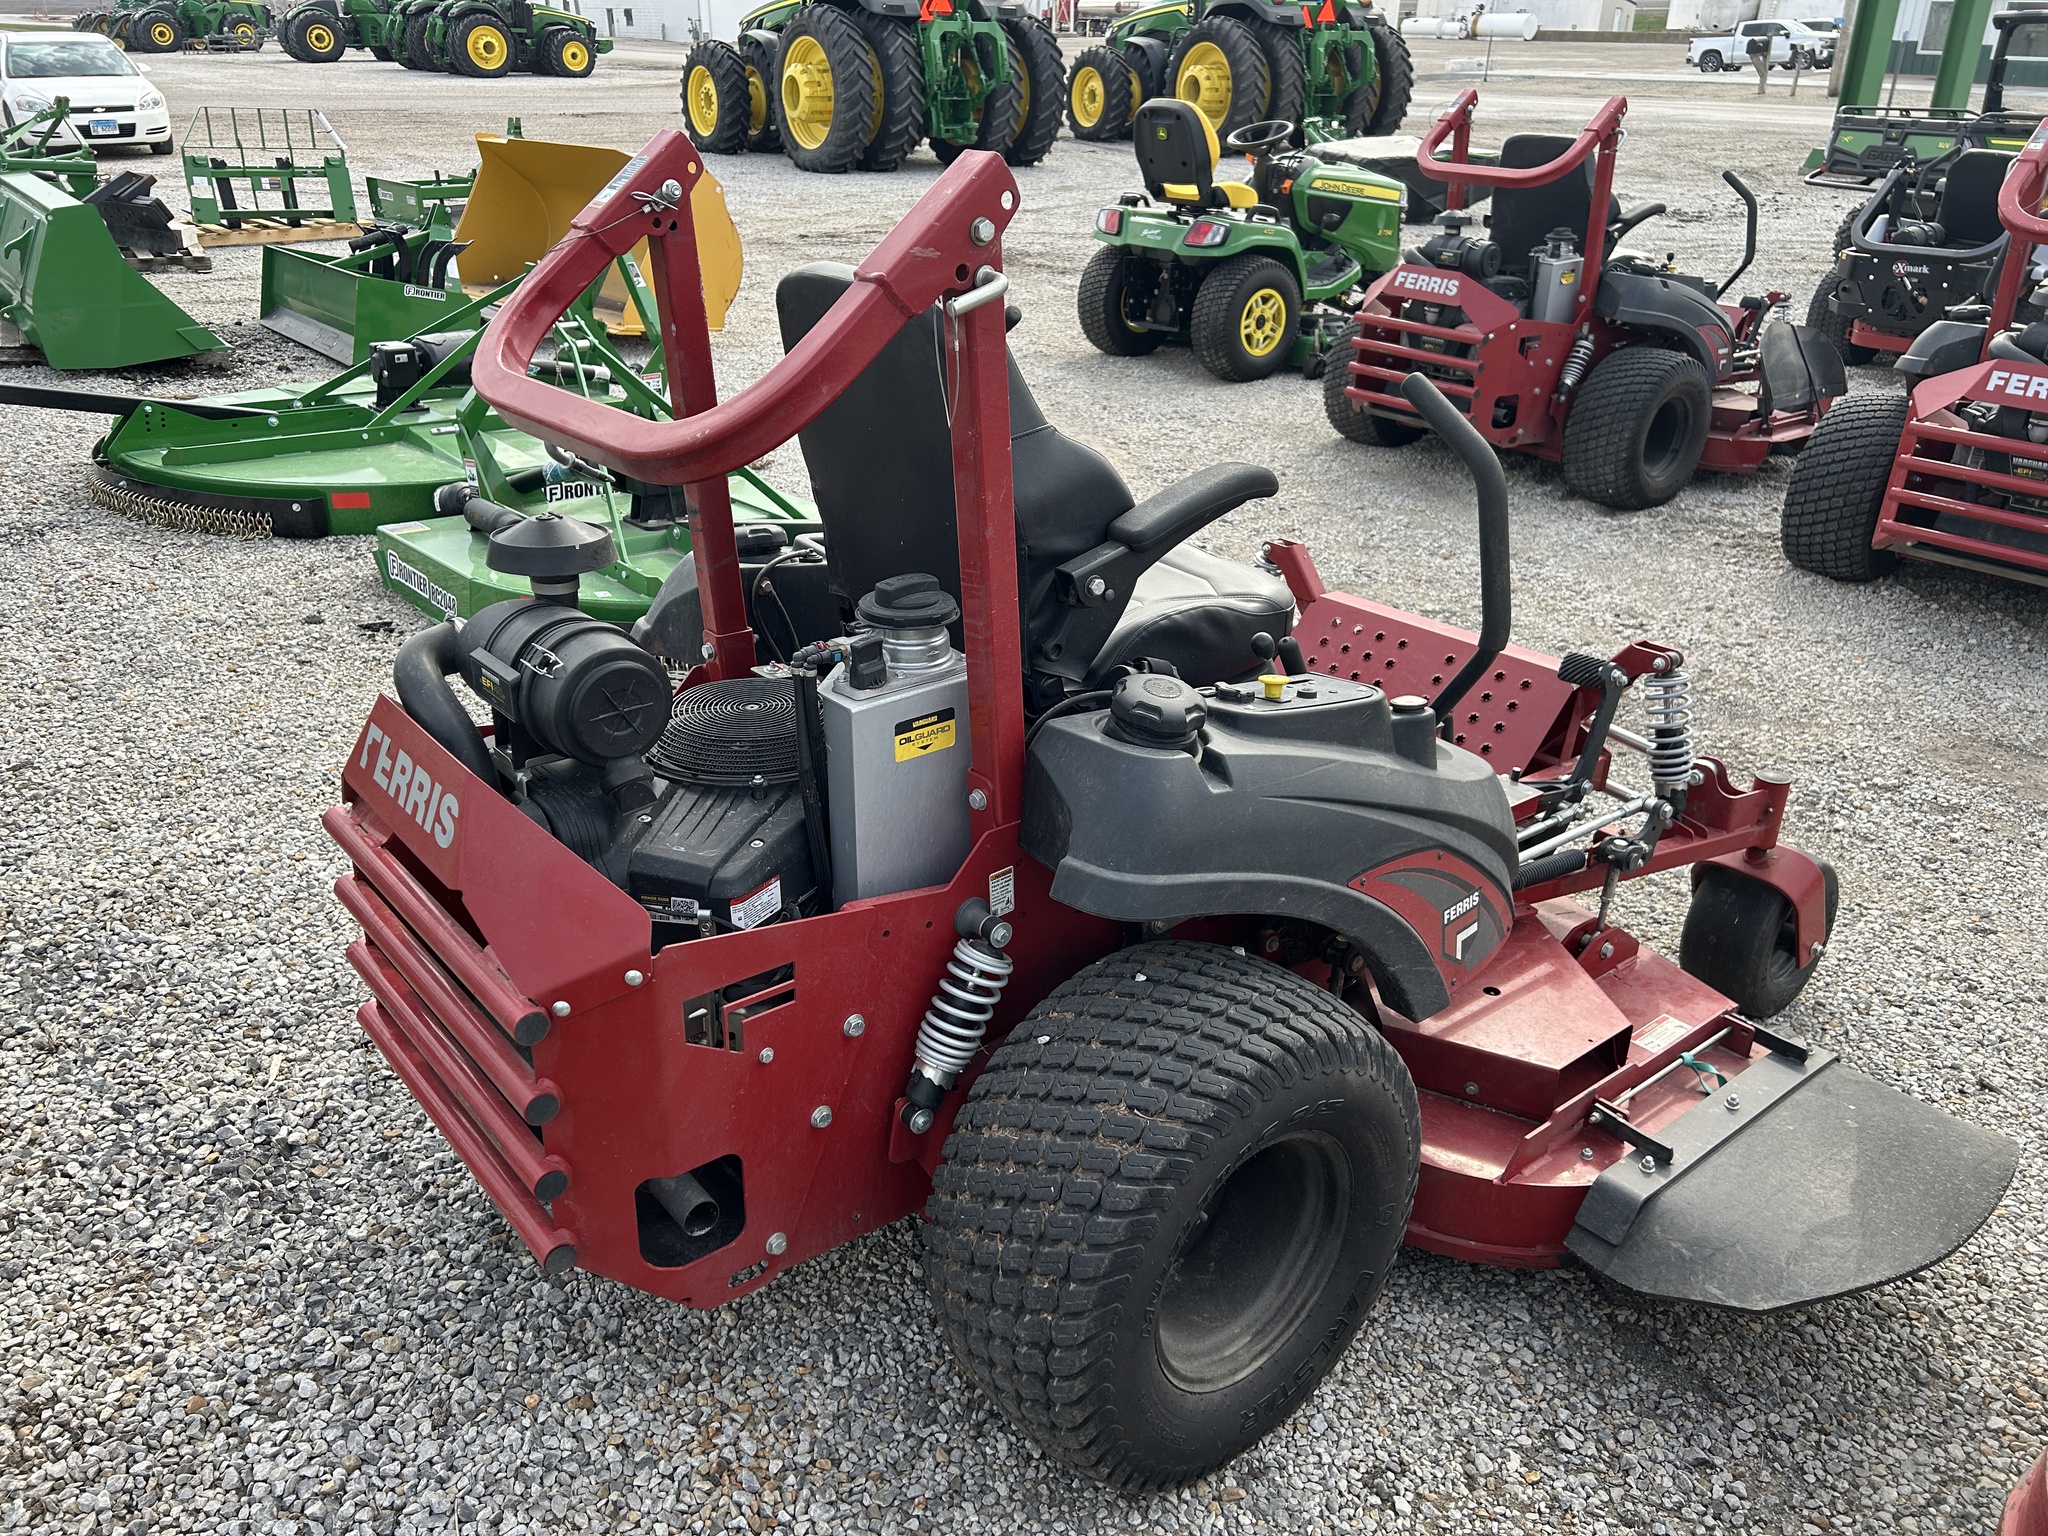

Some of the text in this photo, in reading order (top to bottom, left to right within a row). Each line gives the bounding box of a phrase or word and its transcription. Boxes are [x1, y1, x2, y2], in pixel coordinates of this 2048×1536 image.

[1319, 180, 1366, 196] JOHN DEERE
[405, 286, 445, 300] FRONTIER
[1394, 271, 1460, 296] FERRIS
[388, 551, 428, 597] FRONTIER
[1443, 890, 1480, 925] FERRIS
